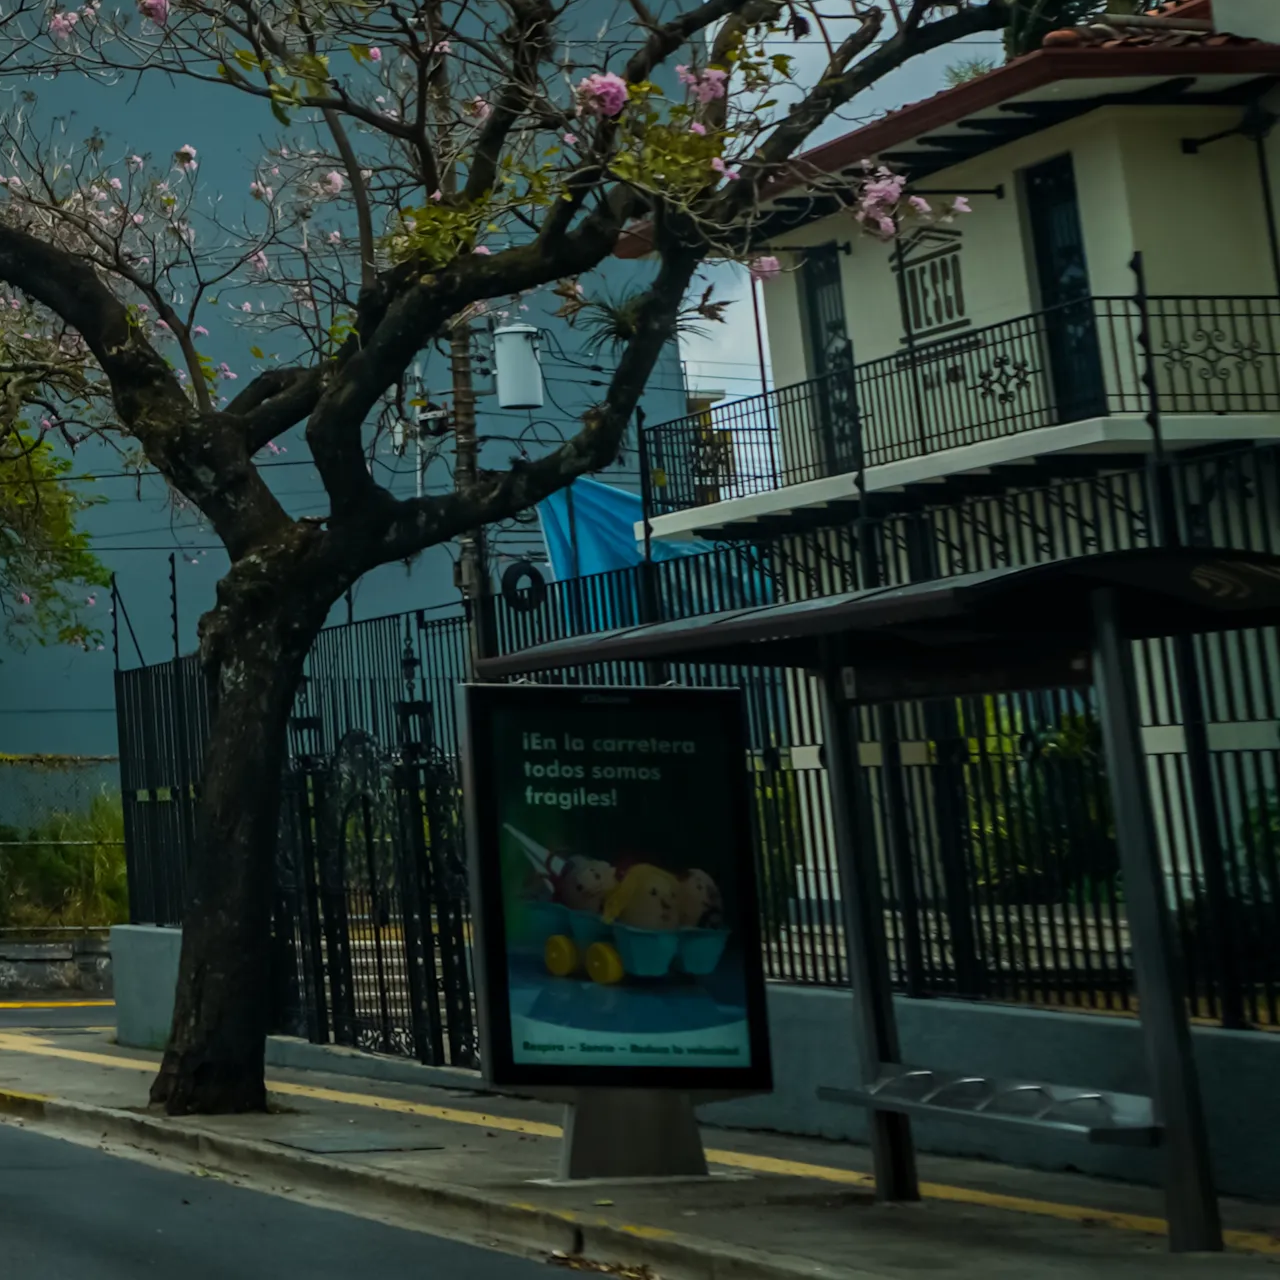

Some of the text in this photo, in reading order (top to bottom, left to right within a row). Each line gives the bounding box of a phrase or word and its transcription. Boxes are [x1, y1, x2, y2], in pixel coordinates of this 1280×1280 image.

[522, 731, 696, 754] ¡En la carretera
[524, 759, 662, 780] todos somos
[524, 784, 618, 810] frágiles!
